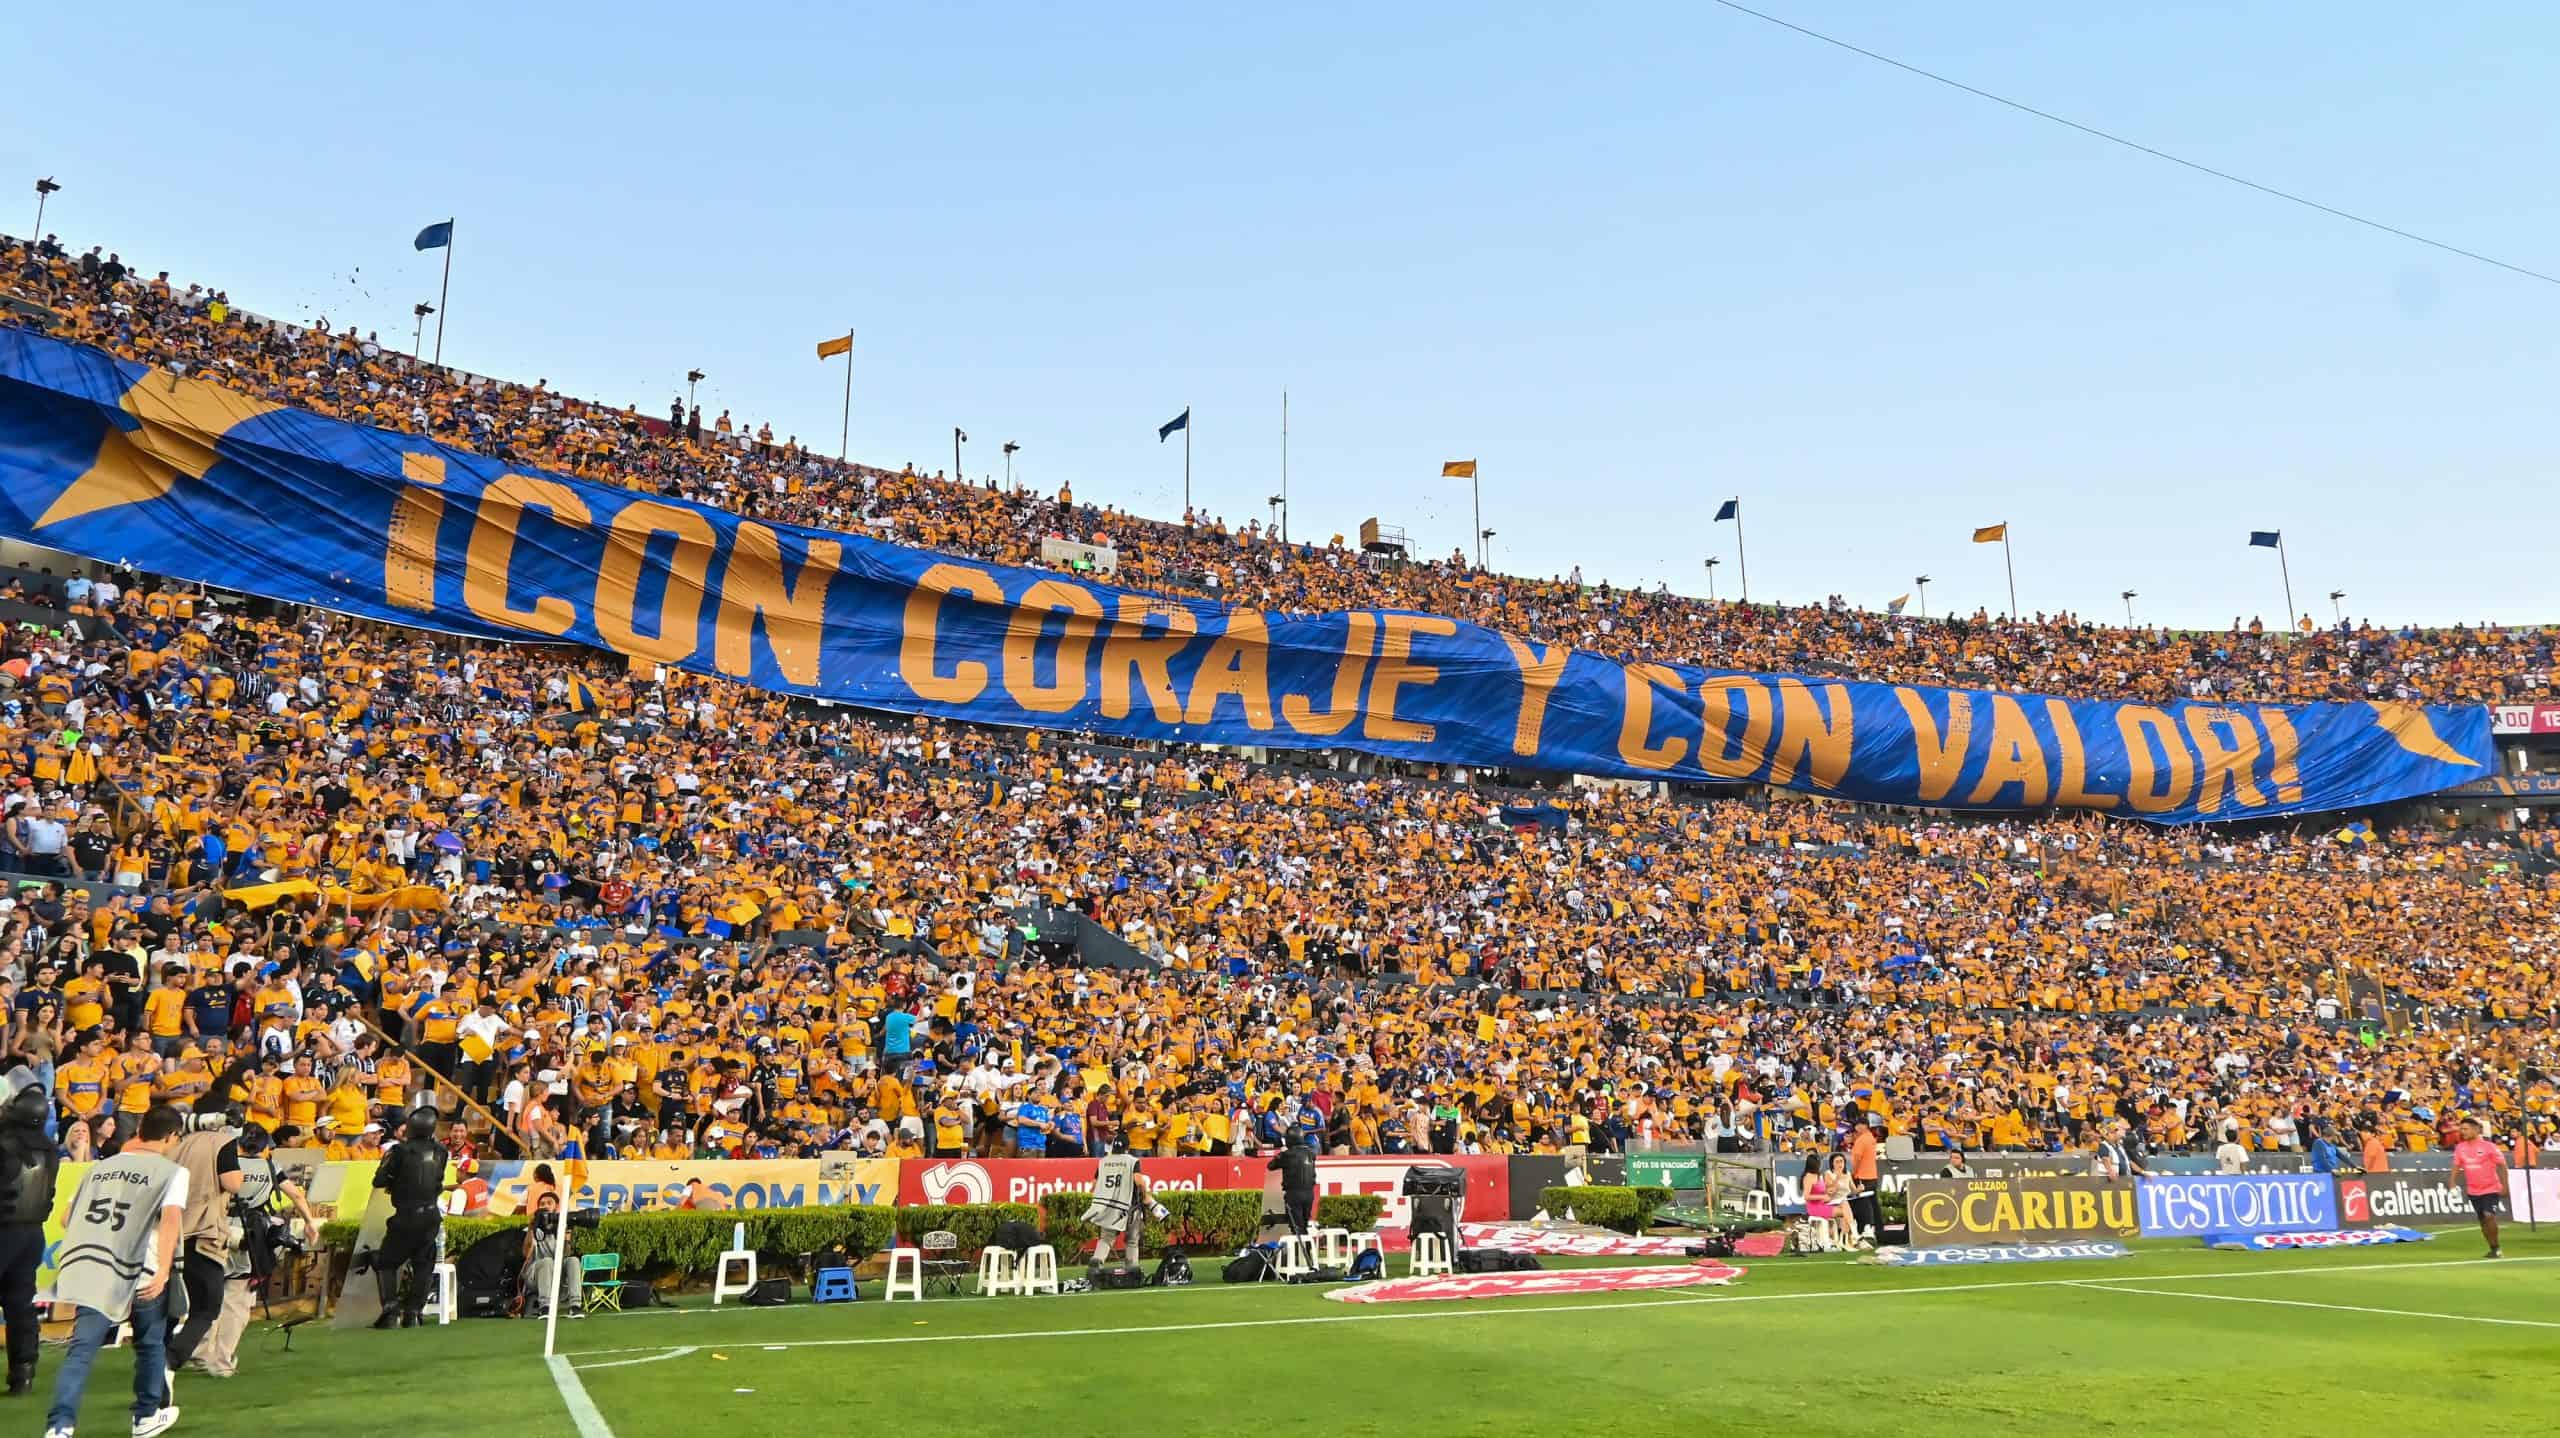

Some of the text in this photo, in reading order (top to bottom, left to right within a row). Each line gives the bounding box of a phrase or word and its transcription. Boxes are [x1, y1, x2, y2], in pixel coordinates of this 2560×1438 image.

[899, 562, 1457, 743] CORAJE
[1499, 629, 1573, 757] Y
[1617, 660, 1856, 791] CON
[1899, 686, 2302, 814] VALOR!
[91, 1170, 150, 1186] PRENSA
[242, 1172, 270, 1184] ENSA
[1968, 1181, 2007, 1191] CALZADO
[84, 1198, 131, 1232] 55
[1960, 1190, 2134, 1232] CARIBU
